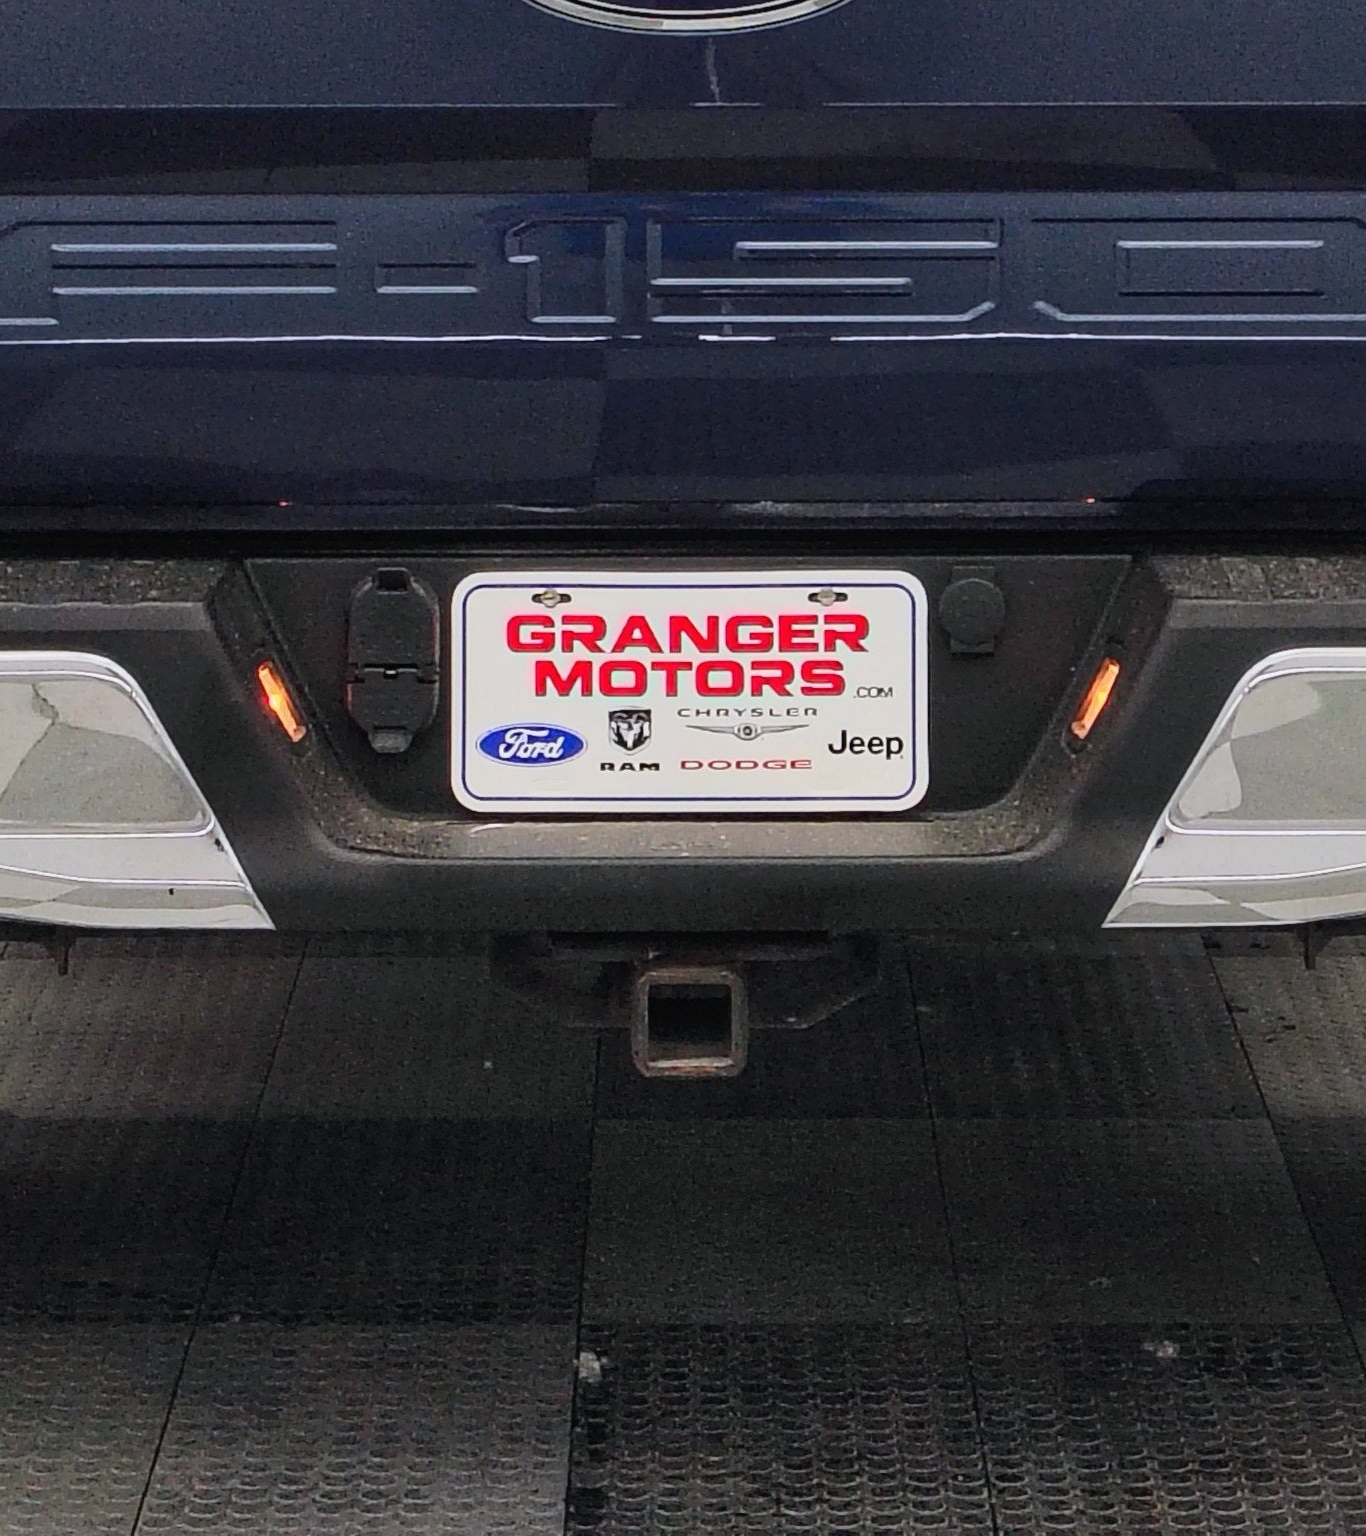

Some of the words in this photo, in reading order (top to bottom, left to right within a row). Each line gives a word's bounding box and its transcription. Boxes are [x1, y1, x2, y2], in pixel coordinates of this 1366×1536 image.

[506, 614, 869, 654] GRANGER
[535, 660, 846, 698] MOTORS
[853, 686, 893, 698] .COM
[677, 708, 818, 717] CHRYSLER
[498, 728, 565, 759] Ford
[828, 730, 903, 759] Jeep
[600, 762, 660, 772] RAM
[680, 759, 813, 770] DODGE
